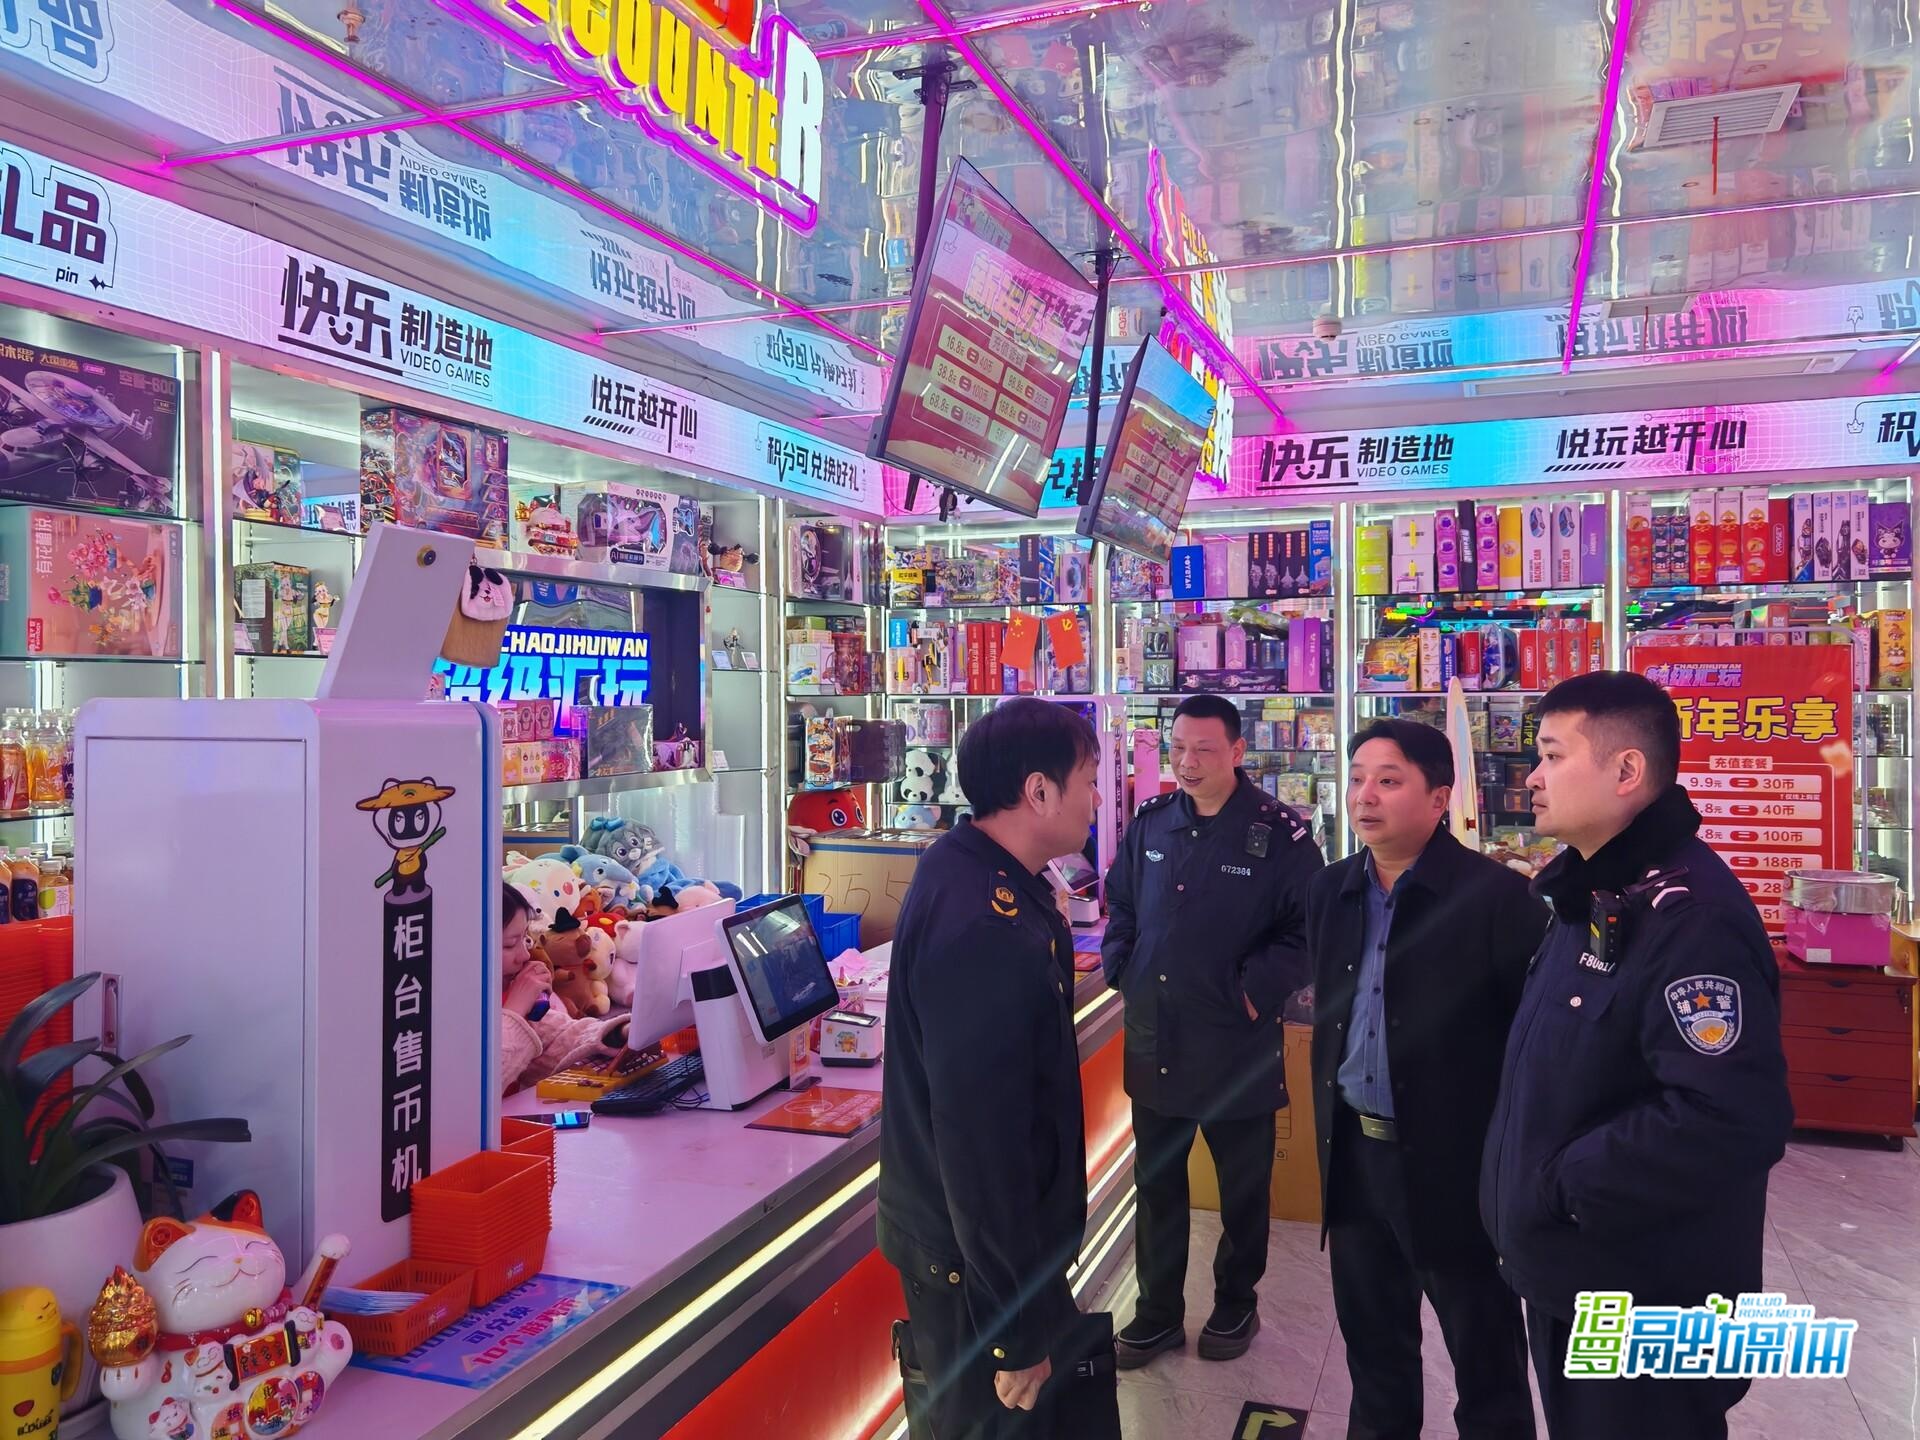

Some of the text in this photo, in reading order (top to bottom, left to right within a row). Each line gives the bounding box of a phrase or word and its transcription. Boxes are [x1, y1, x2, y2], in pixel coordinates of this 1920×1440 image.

[55, 265, 78, 284] pin
[279, 254, 393, 361] 快乐
[399, 301, 493, 371] 制造地
[401, 347, 491, 388] VIDEO GAMES
[591, 373, 698, 454] 悦玩越开心
[1356, 433, 1455, 465] 制造地
[1556, 419, 1748, 471] 悦玩越开心
[1877, 410, 1920, 458] 积
[766, 435, 860, 492] 积分可兑换好礼
[1259, 435, 1350, 482] 快乐
[1356, 463, 1449, 477] VIDEO GAMES
[1714, 757, 1768, 769] 充值套餐
[1690, 777, 1795, 790] 9.9元 30币
[1762, 805, 1795, 816] 40币
[1695, 828, 1803, 843] .8元 100币
[1762, 856, 1803, 869] 188币
[1669, 979, 1734, 1001] 中华人民共和国
[390, 912, 425, 1194] 柜台售币机
